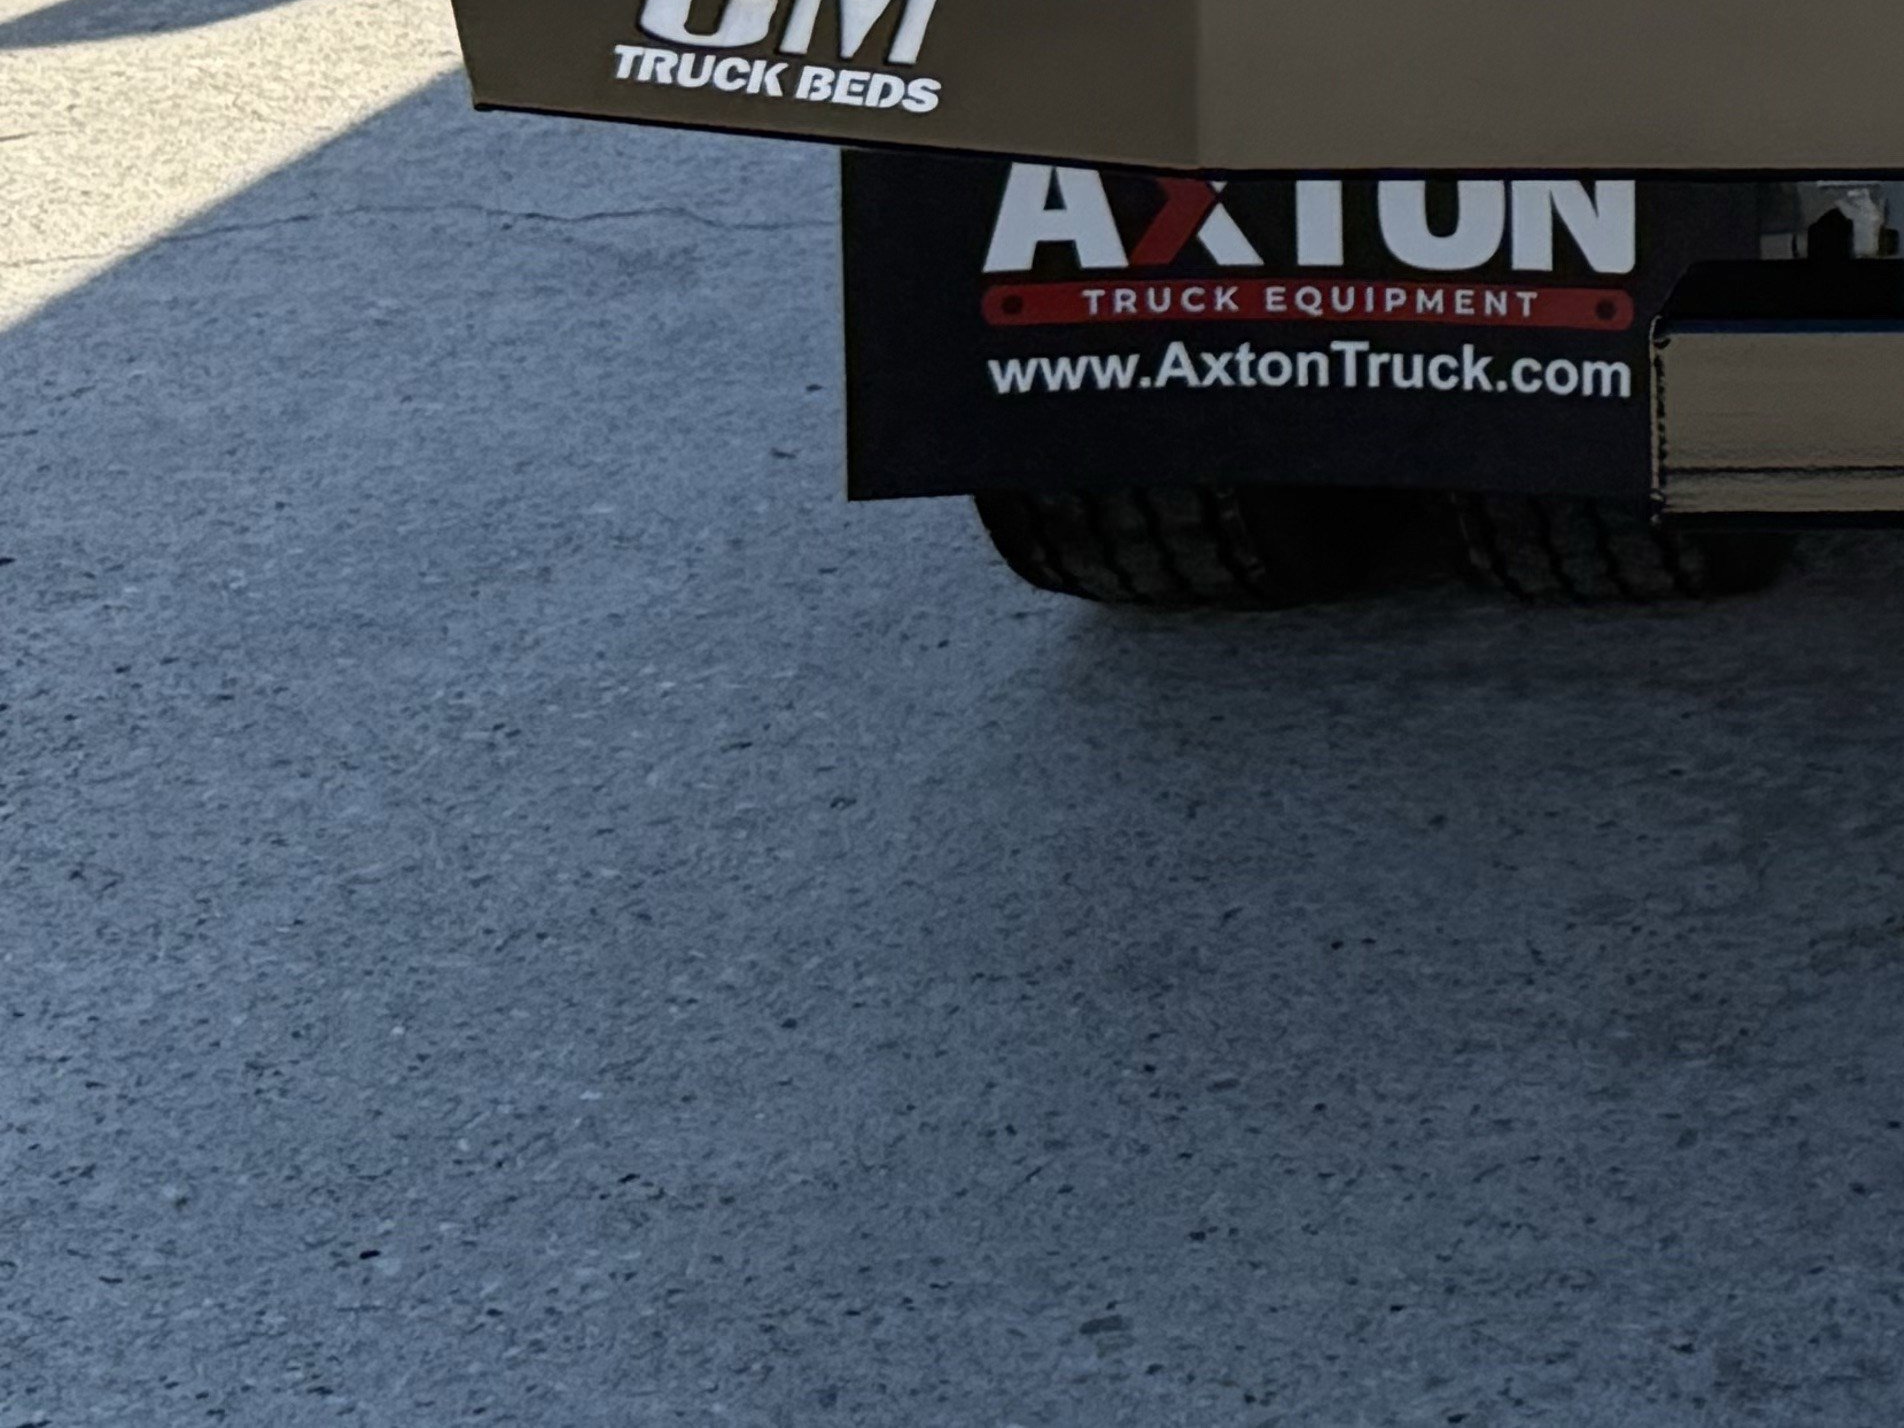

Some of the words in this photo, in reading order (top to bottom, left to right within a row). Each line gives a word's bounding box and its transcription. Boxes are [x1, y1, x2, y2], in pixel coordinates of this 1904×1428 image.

[613, 44, 789, 98] TRUCK
[794, 65, 943, 113] BEDS
[1081, 286, 1240, 316] TRUCK
[1264, 285, 1540, 320] EQUIPMENT
[988, 340, 1632, 399] www.AxtonTruck.com
